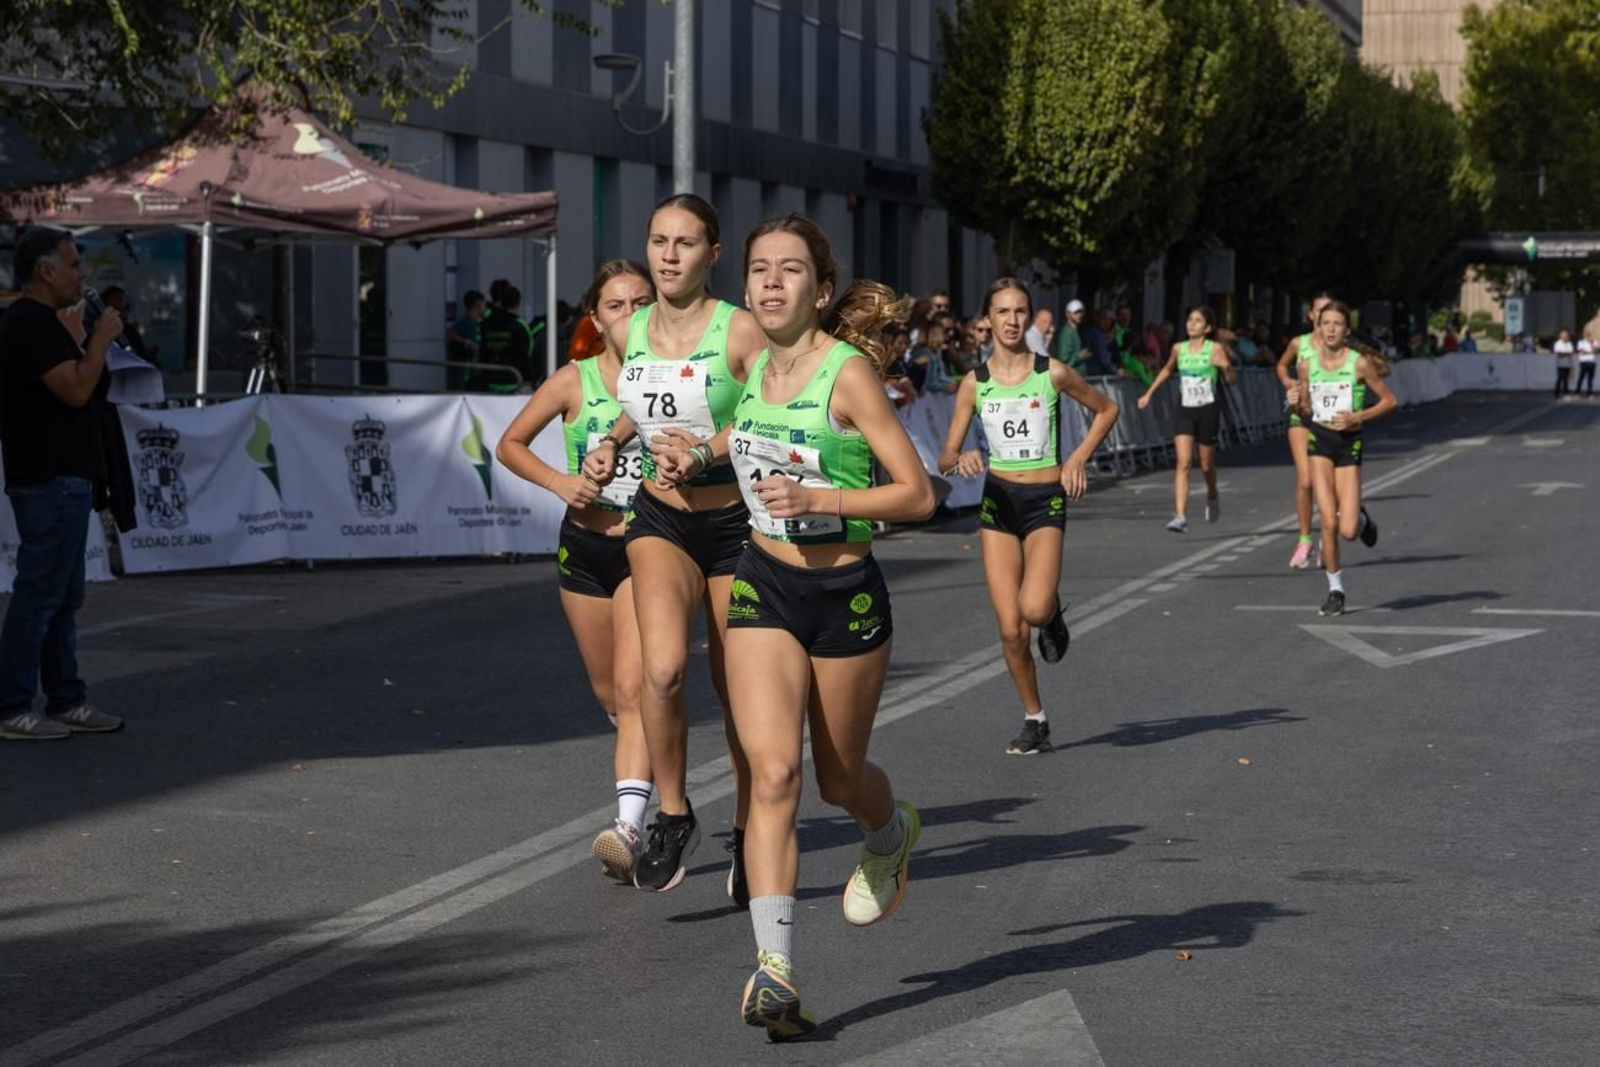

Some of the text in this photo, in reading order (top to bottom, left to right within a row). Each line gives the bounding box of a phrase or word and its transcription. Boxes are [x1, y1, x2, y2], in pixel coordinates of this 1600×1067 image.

[626, 367, 644, 381] 37
[643, 392, 678, 418] 78
[987, 403, 1001, 413] 37
[1322, 395, 1339, 408] 67
[1003, 419, 1030, 438] 64
[734, 438, 751, 456] 37
[341, 524, 378, 537] CIUDAD
[380, 524, 391, 535] DE
[130, 536, 169, 549] CIUDAD
[171, 535, 184, 547] DE
